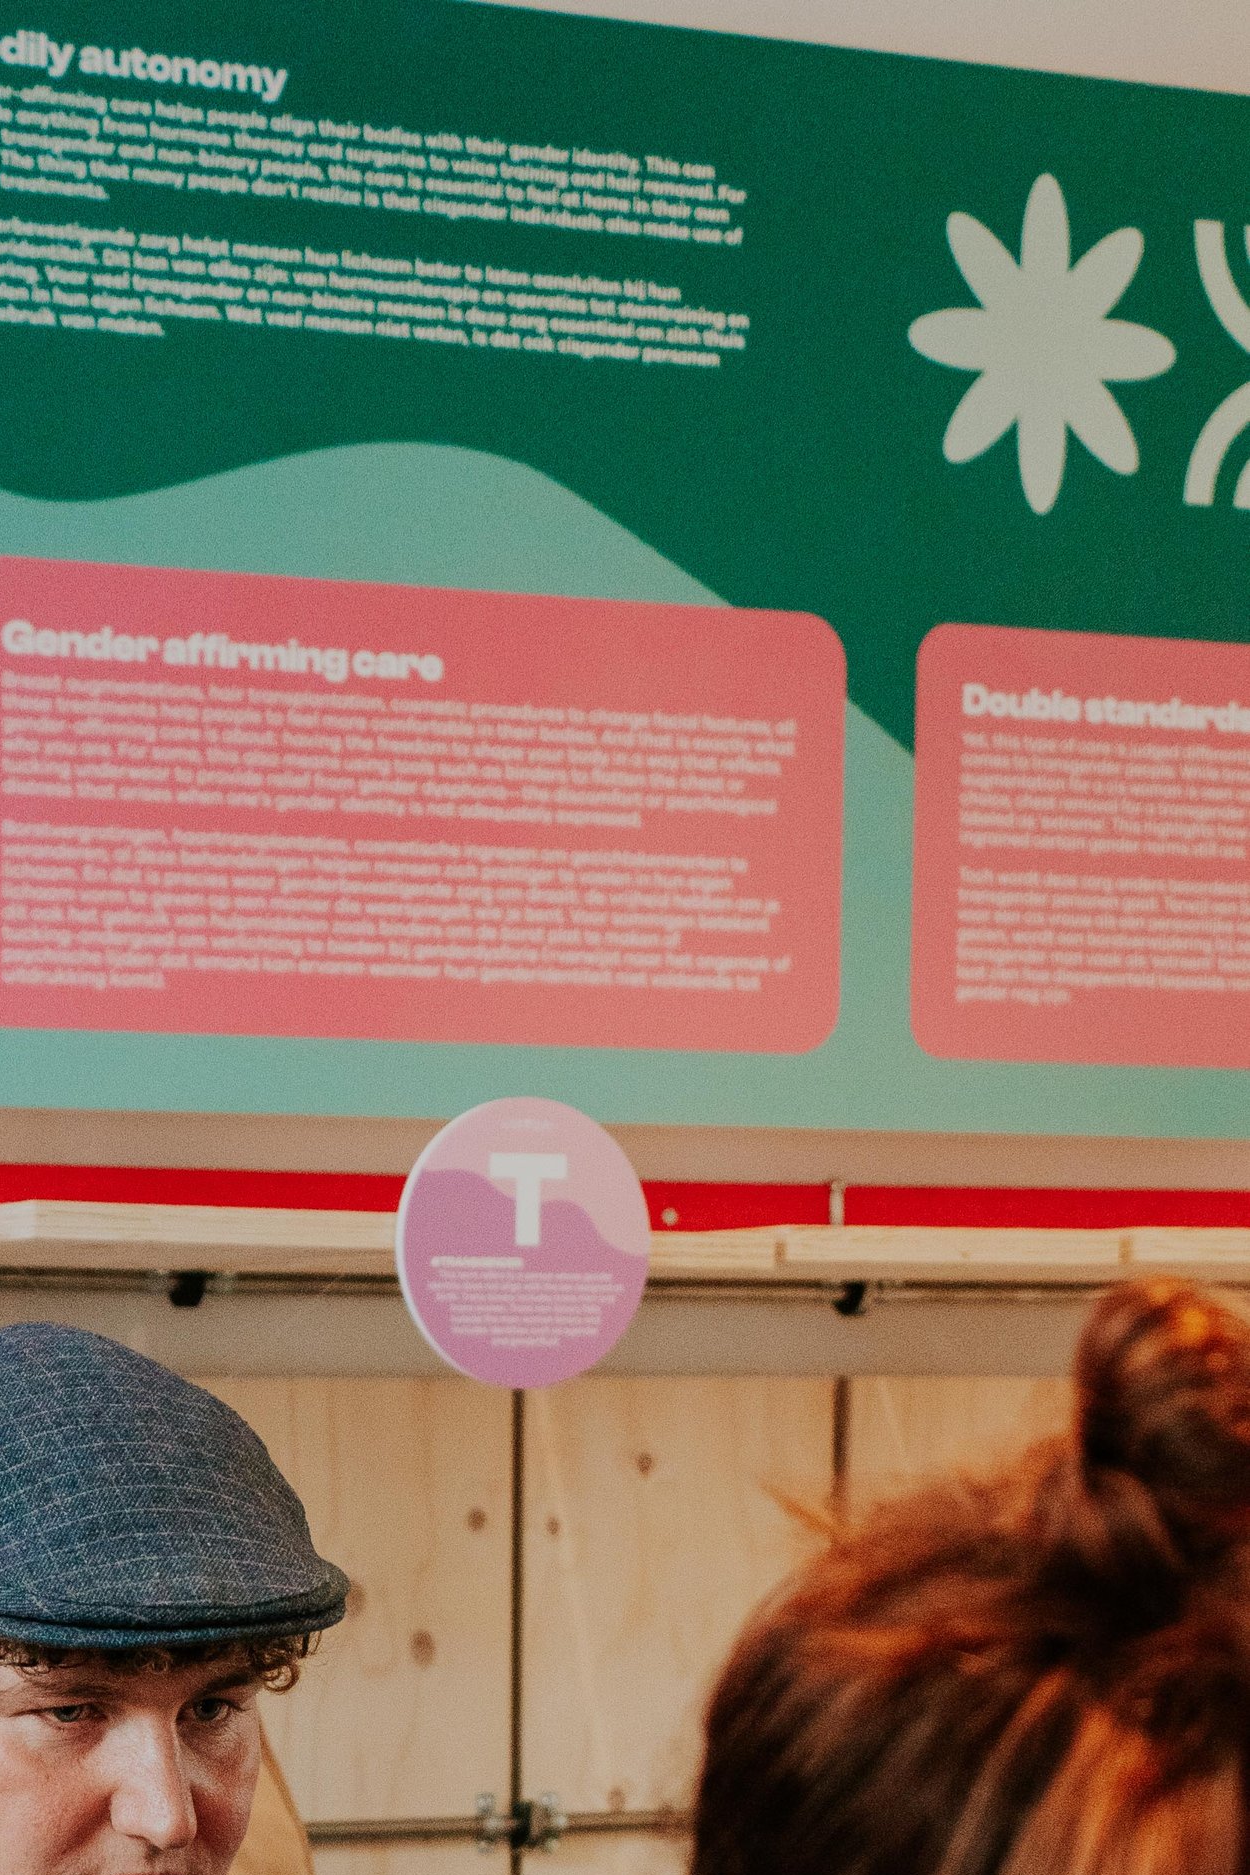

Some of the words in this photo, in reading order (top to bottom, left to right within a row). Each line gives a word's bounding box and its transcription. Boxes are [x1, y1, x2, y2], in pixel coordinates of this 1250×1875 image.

[79, 46, 288, 103] autonomy
[1, 619, 159, 662] Gender
[163, 632, 349, 683] affirming
[352, 649, 445, 682] care
[962, 683, 1080, 722] Double
[489, 1153, 568, 1247] T
